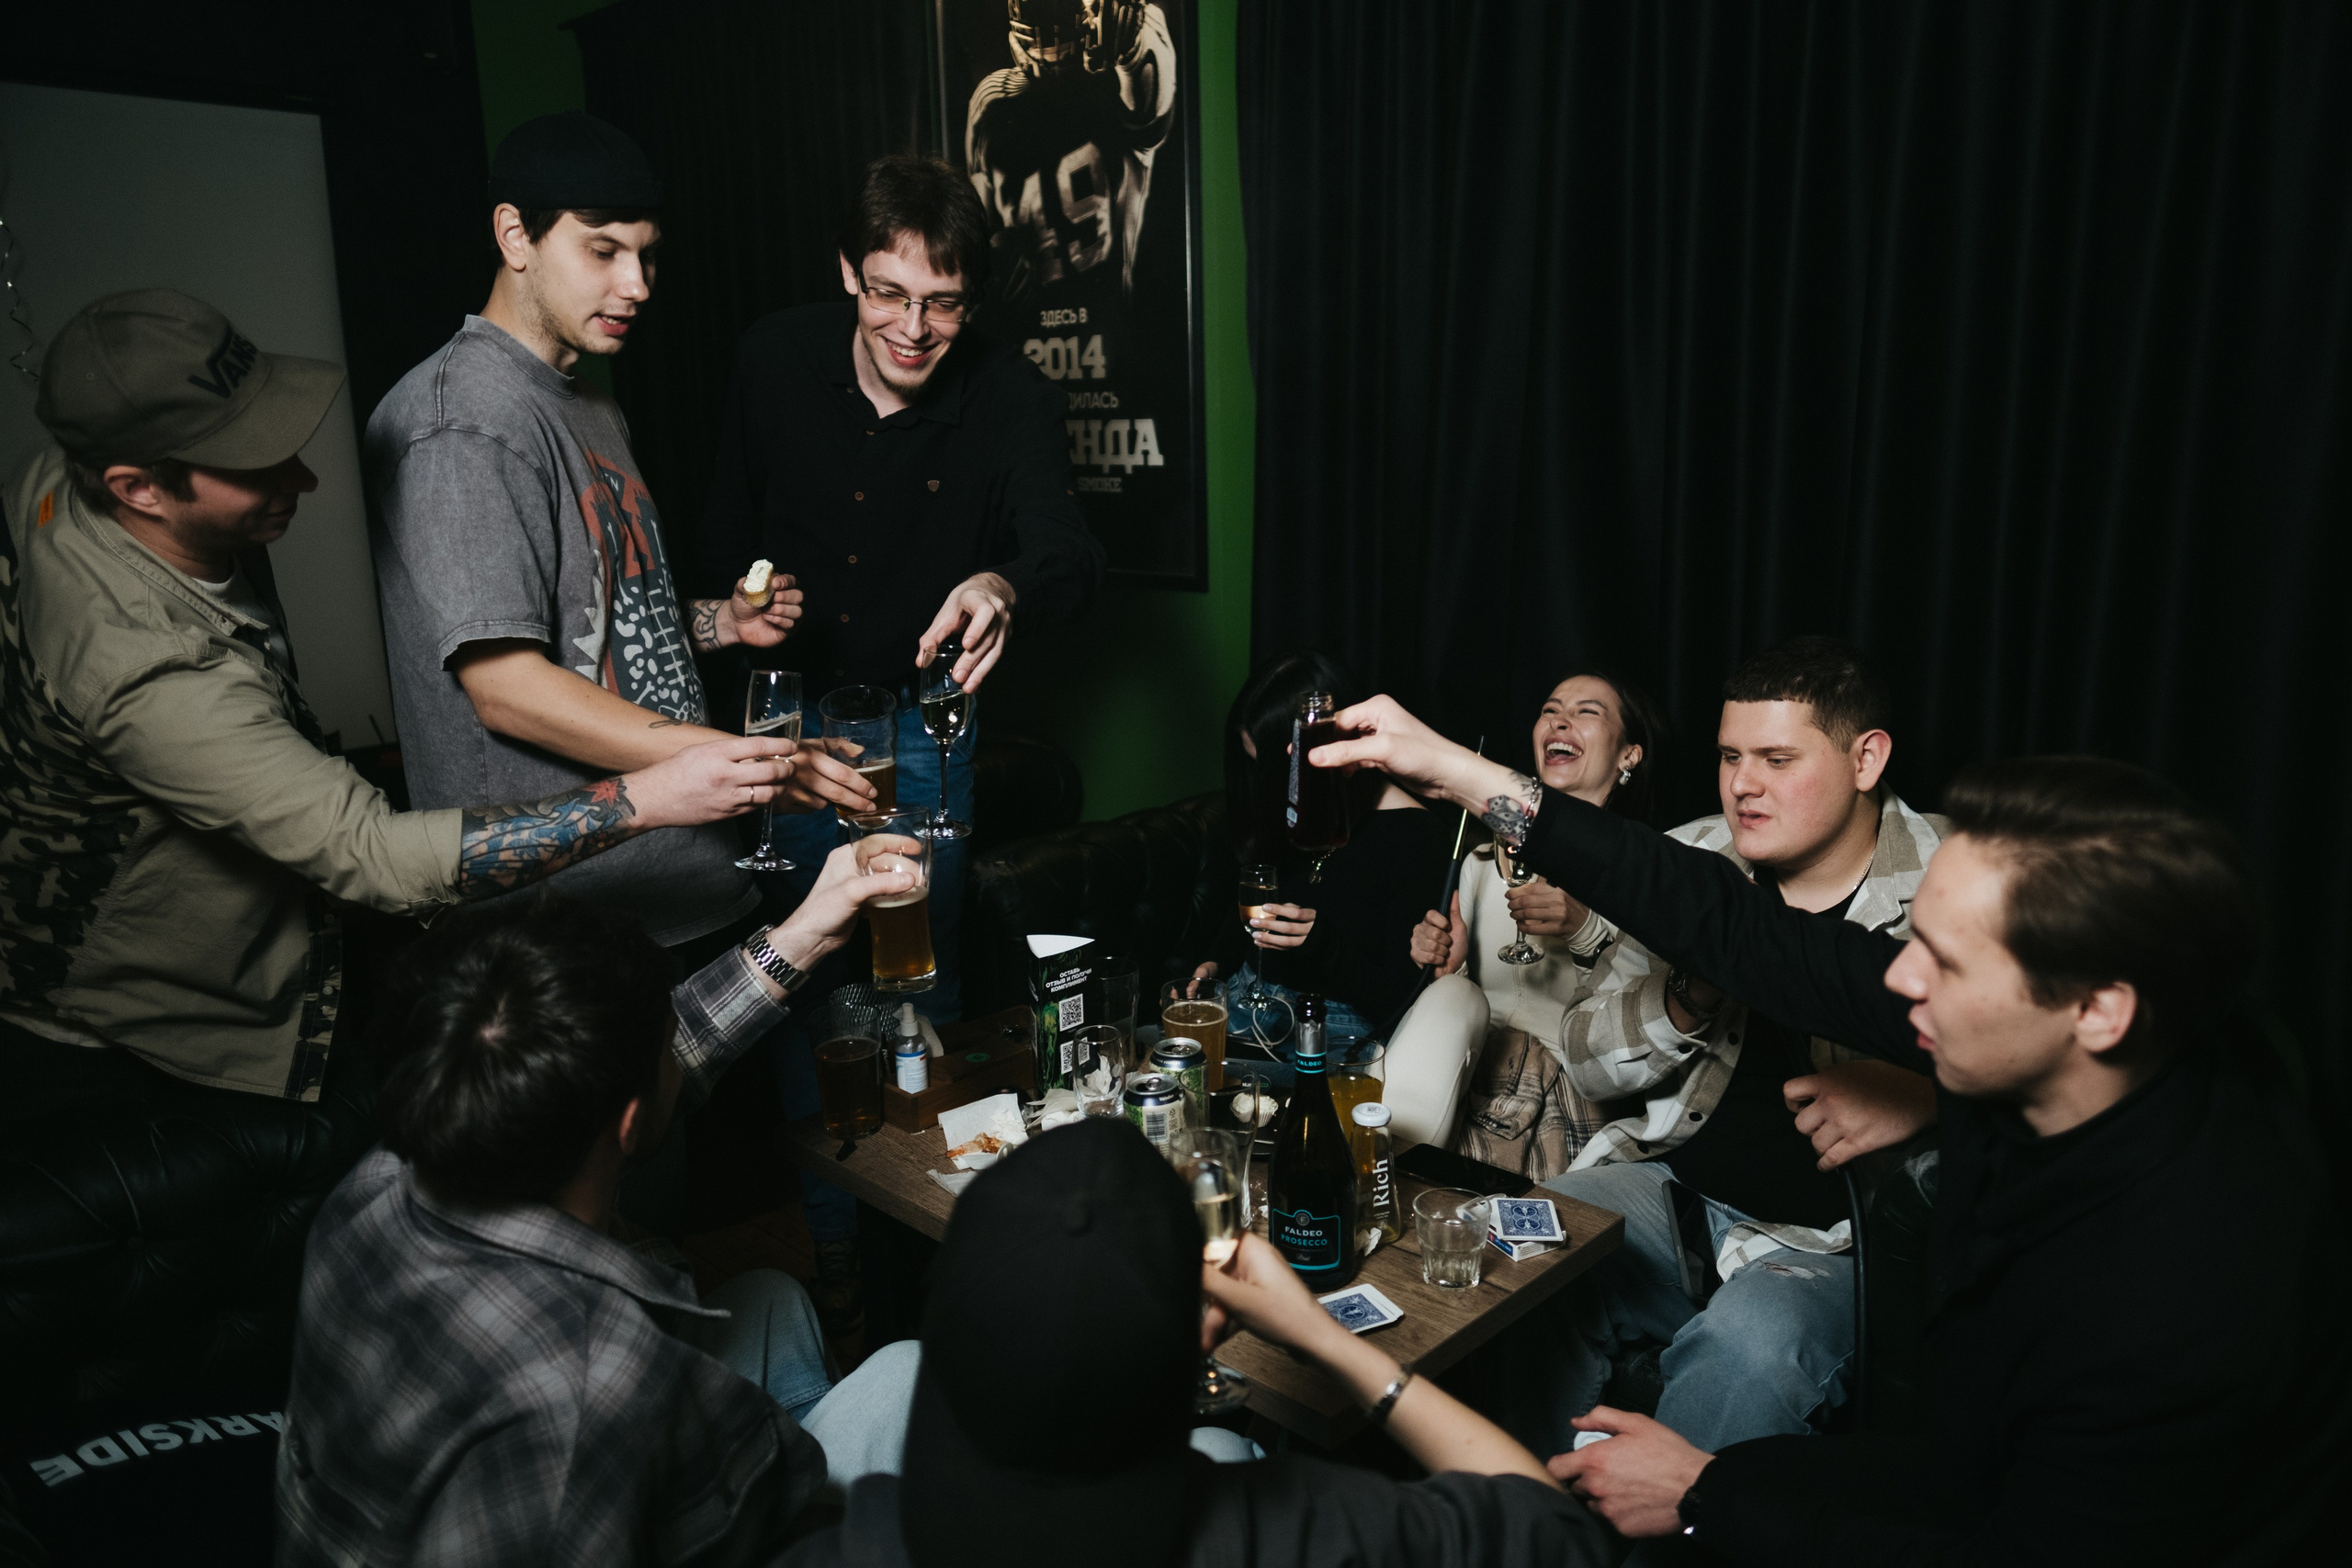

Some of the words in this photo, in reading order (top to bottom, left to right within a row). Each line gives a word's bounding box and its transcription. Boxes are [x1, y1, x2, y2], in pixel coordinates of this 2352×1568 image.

[1040, 310, 1077, 327] ЗДЕСЬ
[1079, 307, 1089, 323] В
[187, 325, 259, 399] VANS
[1023, 333, 1107, 380] 2014
[1046, 977, 1066, 988] ОТЗЫВ
[1071, 968, 1091, 980] ПОЛУЧИ
[1059, 967, 1080, 978] ОСТАВЬ
[1050, 976, 1087, 993] КОМПЛИМЕНТ
[1297, 1059, 1322, 1067] FALDEO
[1372, 1158, 1390, 1208] Rich
[1280, 1234, 1328, 1247] PROSECCO
[1284, 1226, 1323, 1237] FALDEO
[29, 1411, 285, 1487] ARKSIDE
